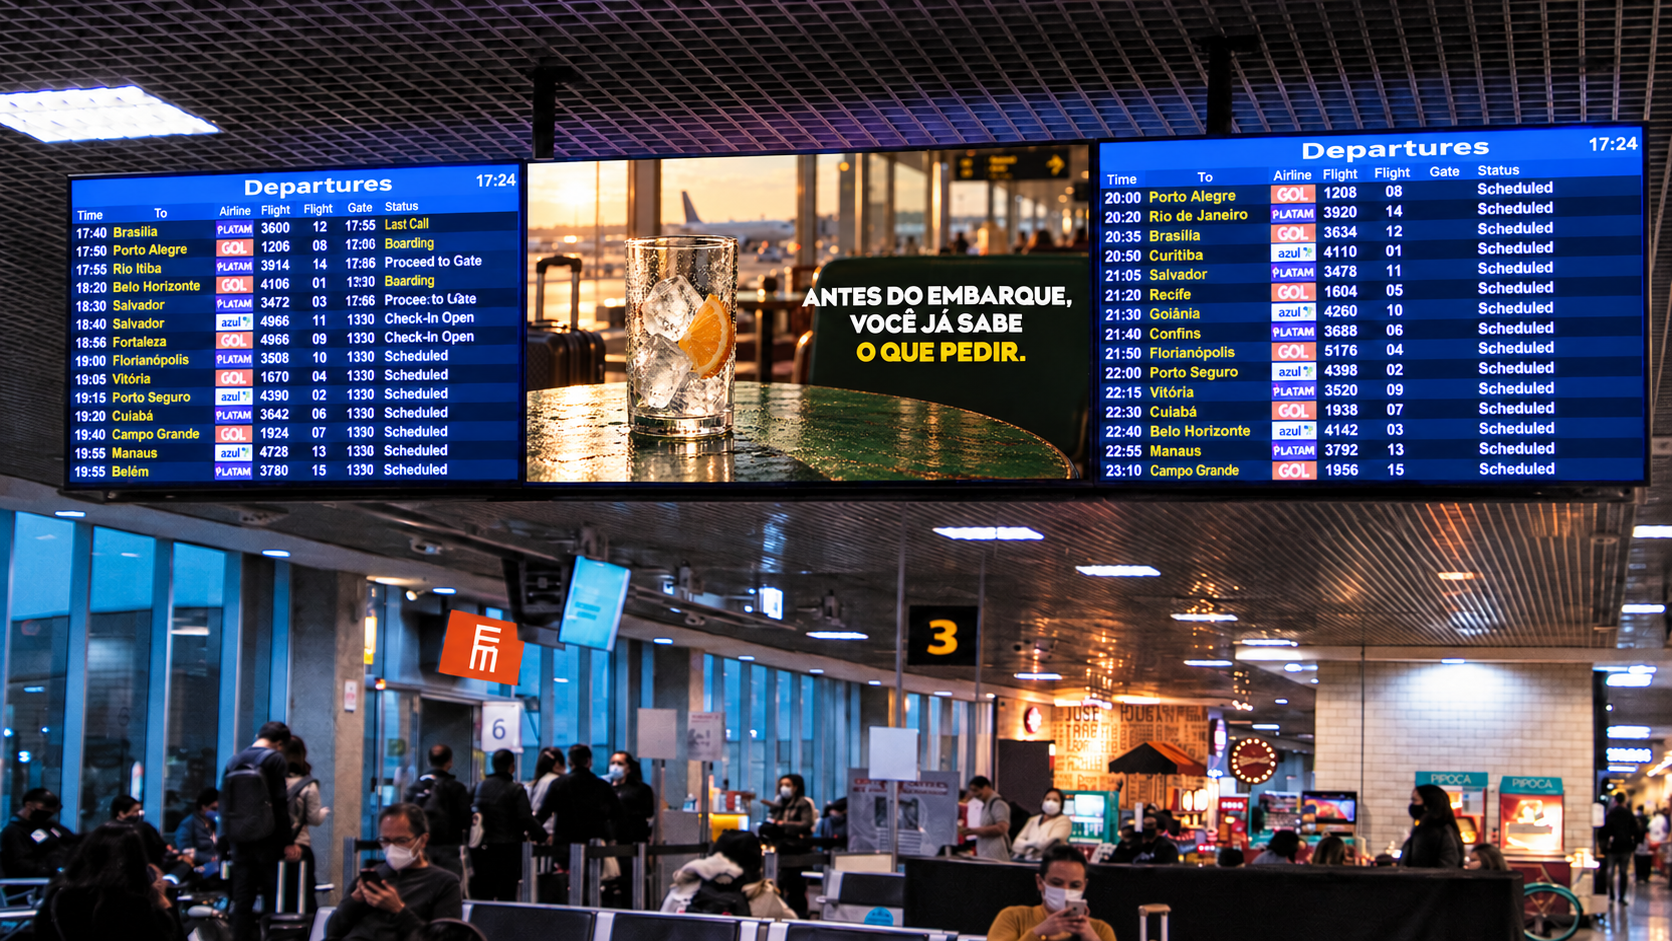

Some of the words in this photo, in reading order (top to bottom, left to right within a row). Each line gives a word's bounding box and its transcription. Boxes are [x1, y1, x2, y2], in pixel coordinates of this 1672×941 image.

[1303, 141, 1489, 162] Departures
[1590, 137, 1638, 151] 17:24
[477, 174, 516, 187] 17:24
[1106, 174, 1137, 184] Time
[1197, 172, 1214, 182] To
[1273, 170, 1312, 181] Airline
[1323, 169, 1358, 181] Flight
[1374, 168, 1411, 180] Flight
[1429, 167, 1460, 176] Gate
[1477, 165, 1520, 175] Status
[245, 178, 392, 199] Departures
[1104, 192, 1142, 204] 20:00
[1150, 191, 1186, 203] Porto
[1191, 190, 1236, 204] Alegre
[1277, 187, 1308, 201] GOL
[1324, 186, 1358, 198] 1208
[76, 211, 104, 220] Time
[154, 208, 168, 218] To
[219, 206, 251, 216] Airline
[261, 205, 291, 217] Flight
[303, 204, 334, 216] Flight
[347, 203, 373, 212] Gate
[385, 202, 419, 211] Status
[1105, 211, 1142, 223] 20:20
[1150, 211, 1172, 222] Rio
[1177, 210, 1192, 221] de
[1197, 209, 1248, 221] Janeiro
[1323, 206, 1358, 218] 3920
[76, 227, 108, 238] 17:40
[261, 222, 290, 233] 3600
[346, 220, 375, 231] 17:55
[385, 219, 407, 229] Last
[410, 218, 428, 229] Call
[1105, 231, 1142, 242] 20:35
[1323, 226, 1358, 238] 3634
[1478, 222, 1553, 234] Scheduled
[76, 246, 108, 257] 17:50
[114, 245, 145, 255] Porto
[149, 244, 187, 257] Alegre
[222, 241, 247, 255] GOL
[261, 240, 291, 252] 1206
[385, 237, 434, 250] Boarding
[1105, 250, 1142, 262] 20:50
[1150, 249, 1203, 261] Curitiba
[1279, 247, 1299, 258] azul
[1323, 246, 1358, 257] 4110
[76, 264, 108, 275] 17:55
[114, 263, 132, 274] Rio
[137, 263, 161, 273] Itiba
[260, 260, 290, 271] 3914
[385, 256, 434, 268] Proceed
[438, 256, 450, 266] to
[454, 255, 482, 266] Gate
[1105, 270, 1142, 281] 21:05
[1150, 269, 1207, 280] Salvador
[1324, 266, 1358, 277] 3478
[76, 282, 107, 293] 18:20
[113, 282, 139, 292] Belo
[144, 281, 200, 291] Horizonte
[260, 278, 290, 289] 4106
[1105, 289, 1142, 301] 21:20
[1324, 285, 1358, 297] 1604
[76, 300, 107, 311] 18:30
[113, 299, 165, 311] Salvador
[260, 297, 290, 308] 3472
[802, 287, 881, 307] ANTES
[887, 286, 923, 306] DO
[928, 286, 1072, 307] EMBARQUE,
[1105, 309, 1142, 320] 21:30
[1150, 308, 1200, 319] Goiânia
[1323, 305, 1358, 317] 4260
[76, 319, 107, 330] 18:40
[113, 318, 165, 329] Salvador
[222, 317, 240, 327] azul
[259, 315, 290, 326] 4966
[385, 312, 438, 324] Check-In
[442, 312, 474, 325] Open
[850, 308, 917, 334] VOCÊ
[920, 309, 954, 334] JÁ
[957, 313, 1023, 333] SABE
[75, 337, 107, 348] 18:56
[113, 336, 166, 347] Fortaleza
[260, 334, 290, 345] 4966
[385, 331, 438, 343] Check-In
[442, 331, 474, 344] Open
[1105, 328, 1142, 340] 21:40
[1150, 328, 1201, 339] Confins
[1324, 325, 1358, 336] 3688
[75, 356, 107, 366] 19:00
[113, 354, 189, 367] Florianópolis
[260, 352, 290, 363] 3508
[857, 342, 876, 362] O
[880, 342, 934, 362] QUE
[940, 341, 1026, 362] PEDIR.
[1105, 348, 1142, 359] 21:50
[1150, 346, 1235, 361] Florianópolis
[1324, 345, 1358, 356] 5176
[75, 374, 107, 384] 19:05
[113, 373, 150, 384] Vitória
[260, 371, 290, 382] 1670
[385, 369, 448, 380] Scheduled
[1105, 367, 1142, 378] 22:00
[1151, 367, 1186, 378] Porto
[1191, 366, 1238, 380] Seguro
[1324, 364, 1358, 376] 4398
[75, 393, 107, 403] 19:15
[113, 392, 145, 403] Porto
[148, 392, 190, 405] Seguro
[259, 390, 289, 401] 4390
[1105, 387, 1142, 398] 22:15
[1150, 386, 1194, 398] Vitória
[1324, 384, 1358, 396] 3520
[1479, 382, 1554, 394] Scheduled
[75, 411, 106, 421] 19:20
[112, 410, 153, 421] Cuiabá
[260, 409, 290, 420] 3642
[1105, 406, 1142, 418] 22:30
[1150, 406, 1196, 417] Cuiabá
[1325, 404, 1359, 415] 1938
[74, 429, 106, 440] 19:40
[112, 429, 153, 442] Campo
[157, 428, 199, 439] Grande
[260, 427, 289, 438] 1924
[1105, 426, 1142, 437] 22:40
[1151, 426, 1180, 437] Belo
[1185, 425, 1250, 436] Horizonte
[1324, 424, 1359, 435] 4142
[74, 448, 106, 458] 19:55
[112, 447, 157, 458] Manaus
[259, 446, 289, 457] 4728
[385, 444, 447, 456] Scheduled
[1105, 445, 1142, 456] 22:55
[1151, 445, 1201, 456] Manaus
[1325, 444, 1359, 456] 3792
[74, 466, 106, 477] 19:55
[112, 466, 148, 477] Belém
[259, 465, 289, 476] 3780
[1105, 465, 1142, 476] 23:10
[1151, 465, 1193, 479] Campo
[1196, 464, 1239, 476] Grande
[1325, 464, 1359, 475] 1956
[927, 619, 958, 655] 3
[492, 718, 506, 740] 6
[1512, 778, 1553, 789] PIPOCA
